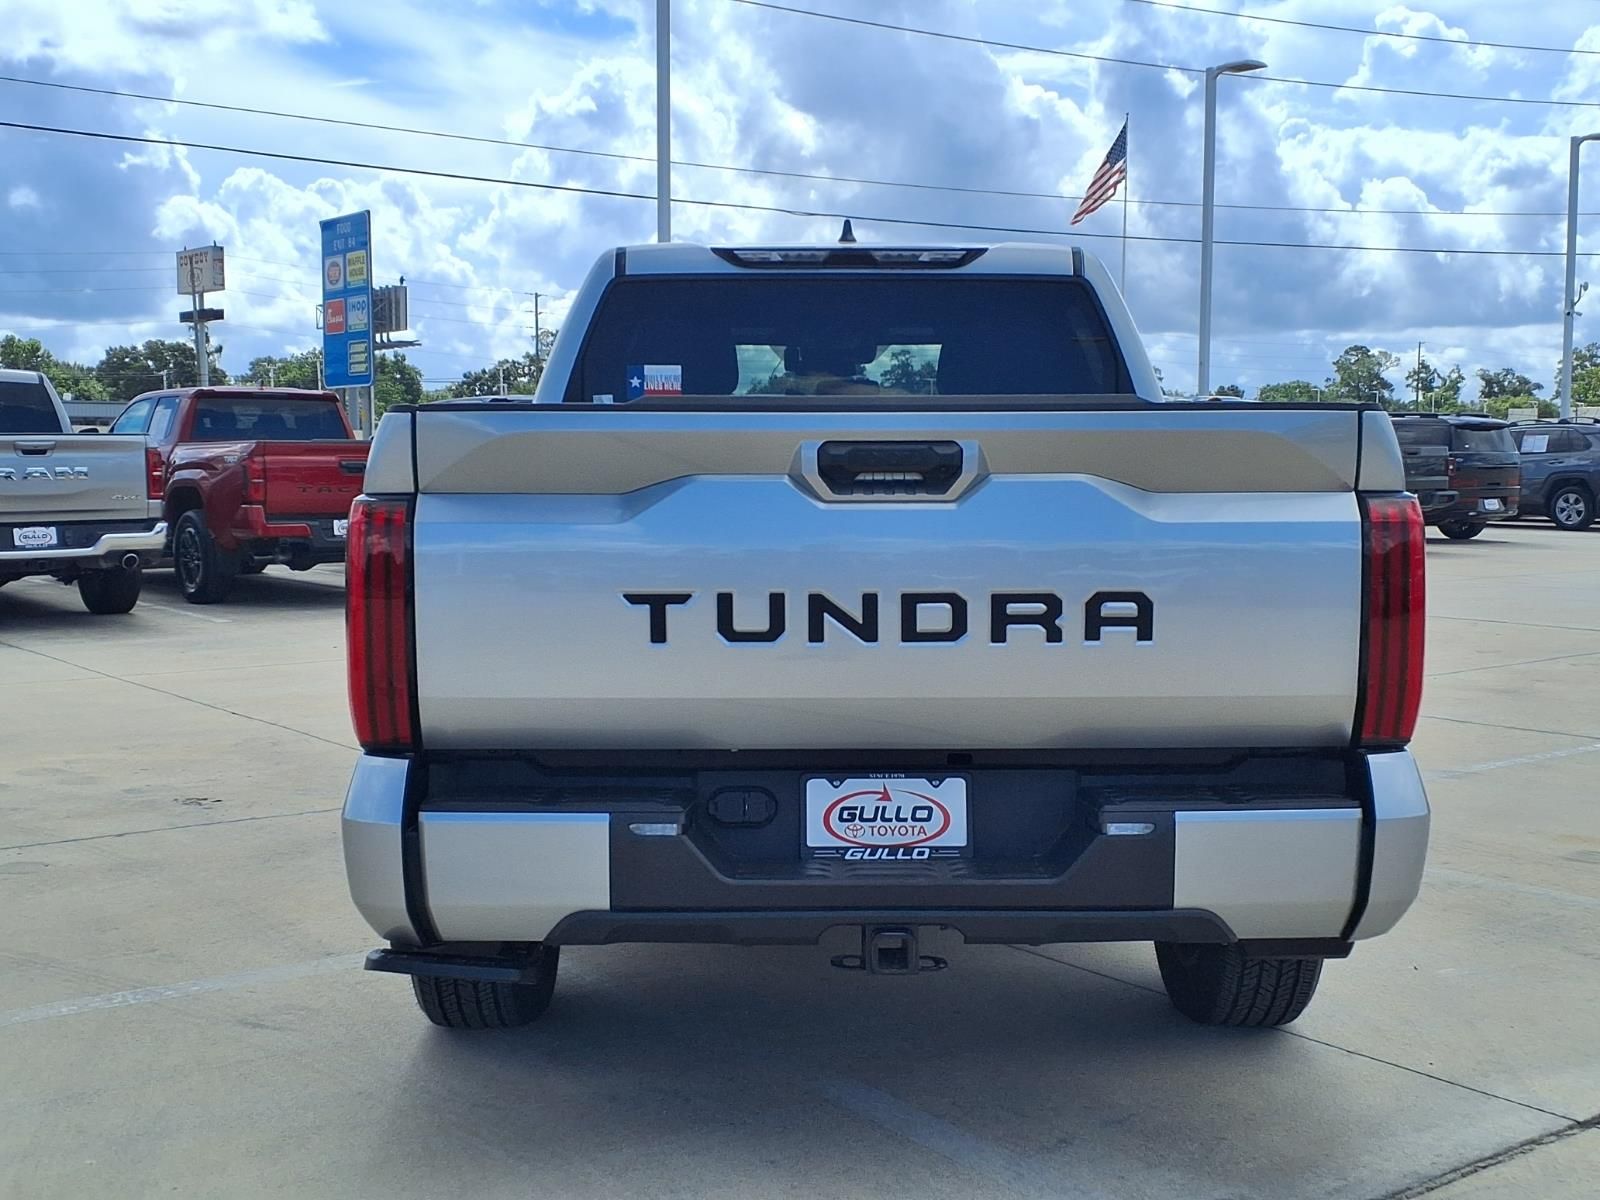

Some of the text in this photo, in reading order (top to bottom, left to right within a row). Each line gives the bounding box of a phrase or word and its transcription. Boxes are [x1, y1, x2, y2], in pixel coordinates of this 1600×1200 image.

[296, 486, 361, 494] TAC
[622, 591, 1154, 643] TUNDRA
[838, 805, 933, 822] GULLO
[869, 825, 927, 836] TOYOTA
[844, 847, 930, 860] GULLO
